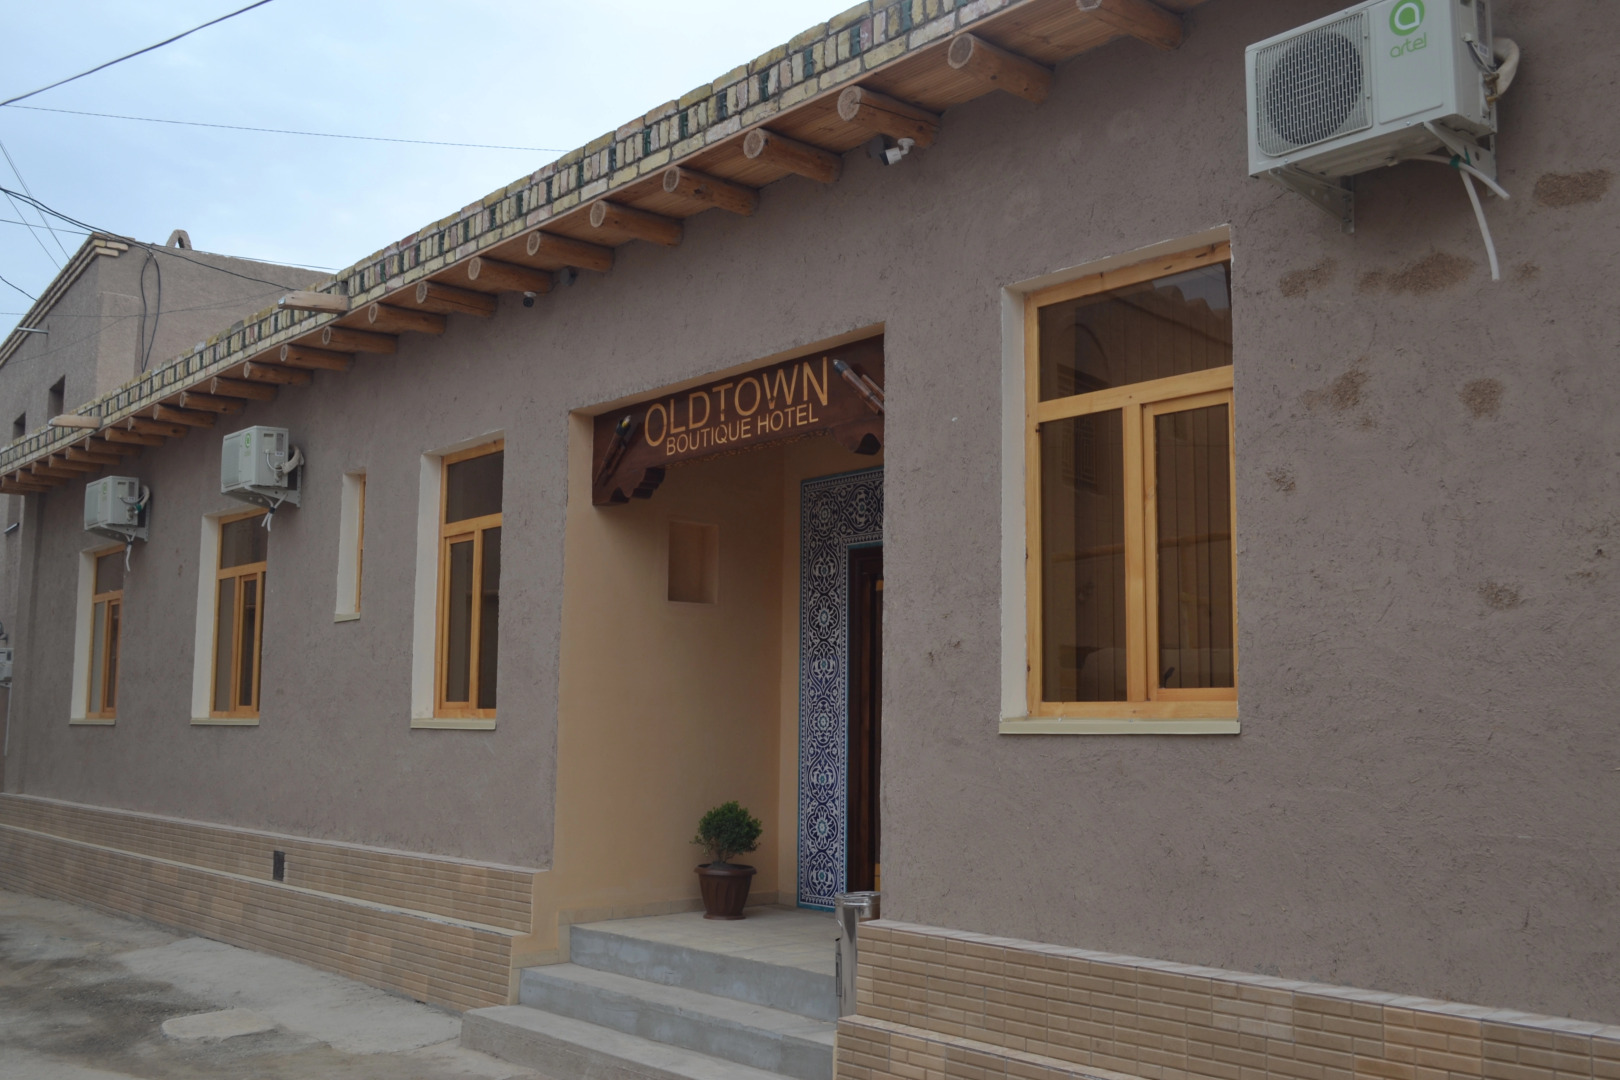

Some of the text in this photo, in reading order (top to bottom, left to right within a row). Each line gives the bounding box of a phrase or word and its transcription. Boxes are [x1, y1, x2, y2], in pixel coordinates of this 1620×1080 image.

[1389, 32, 1427, 58] artel
[666, 403, 819, 456] BOUTIQUE HOTEL
